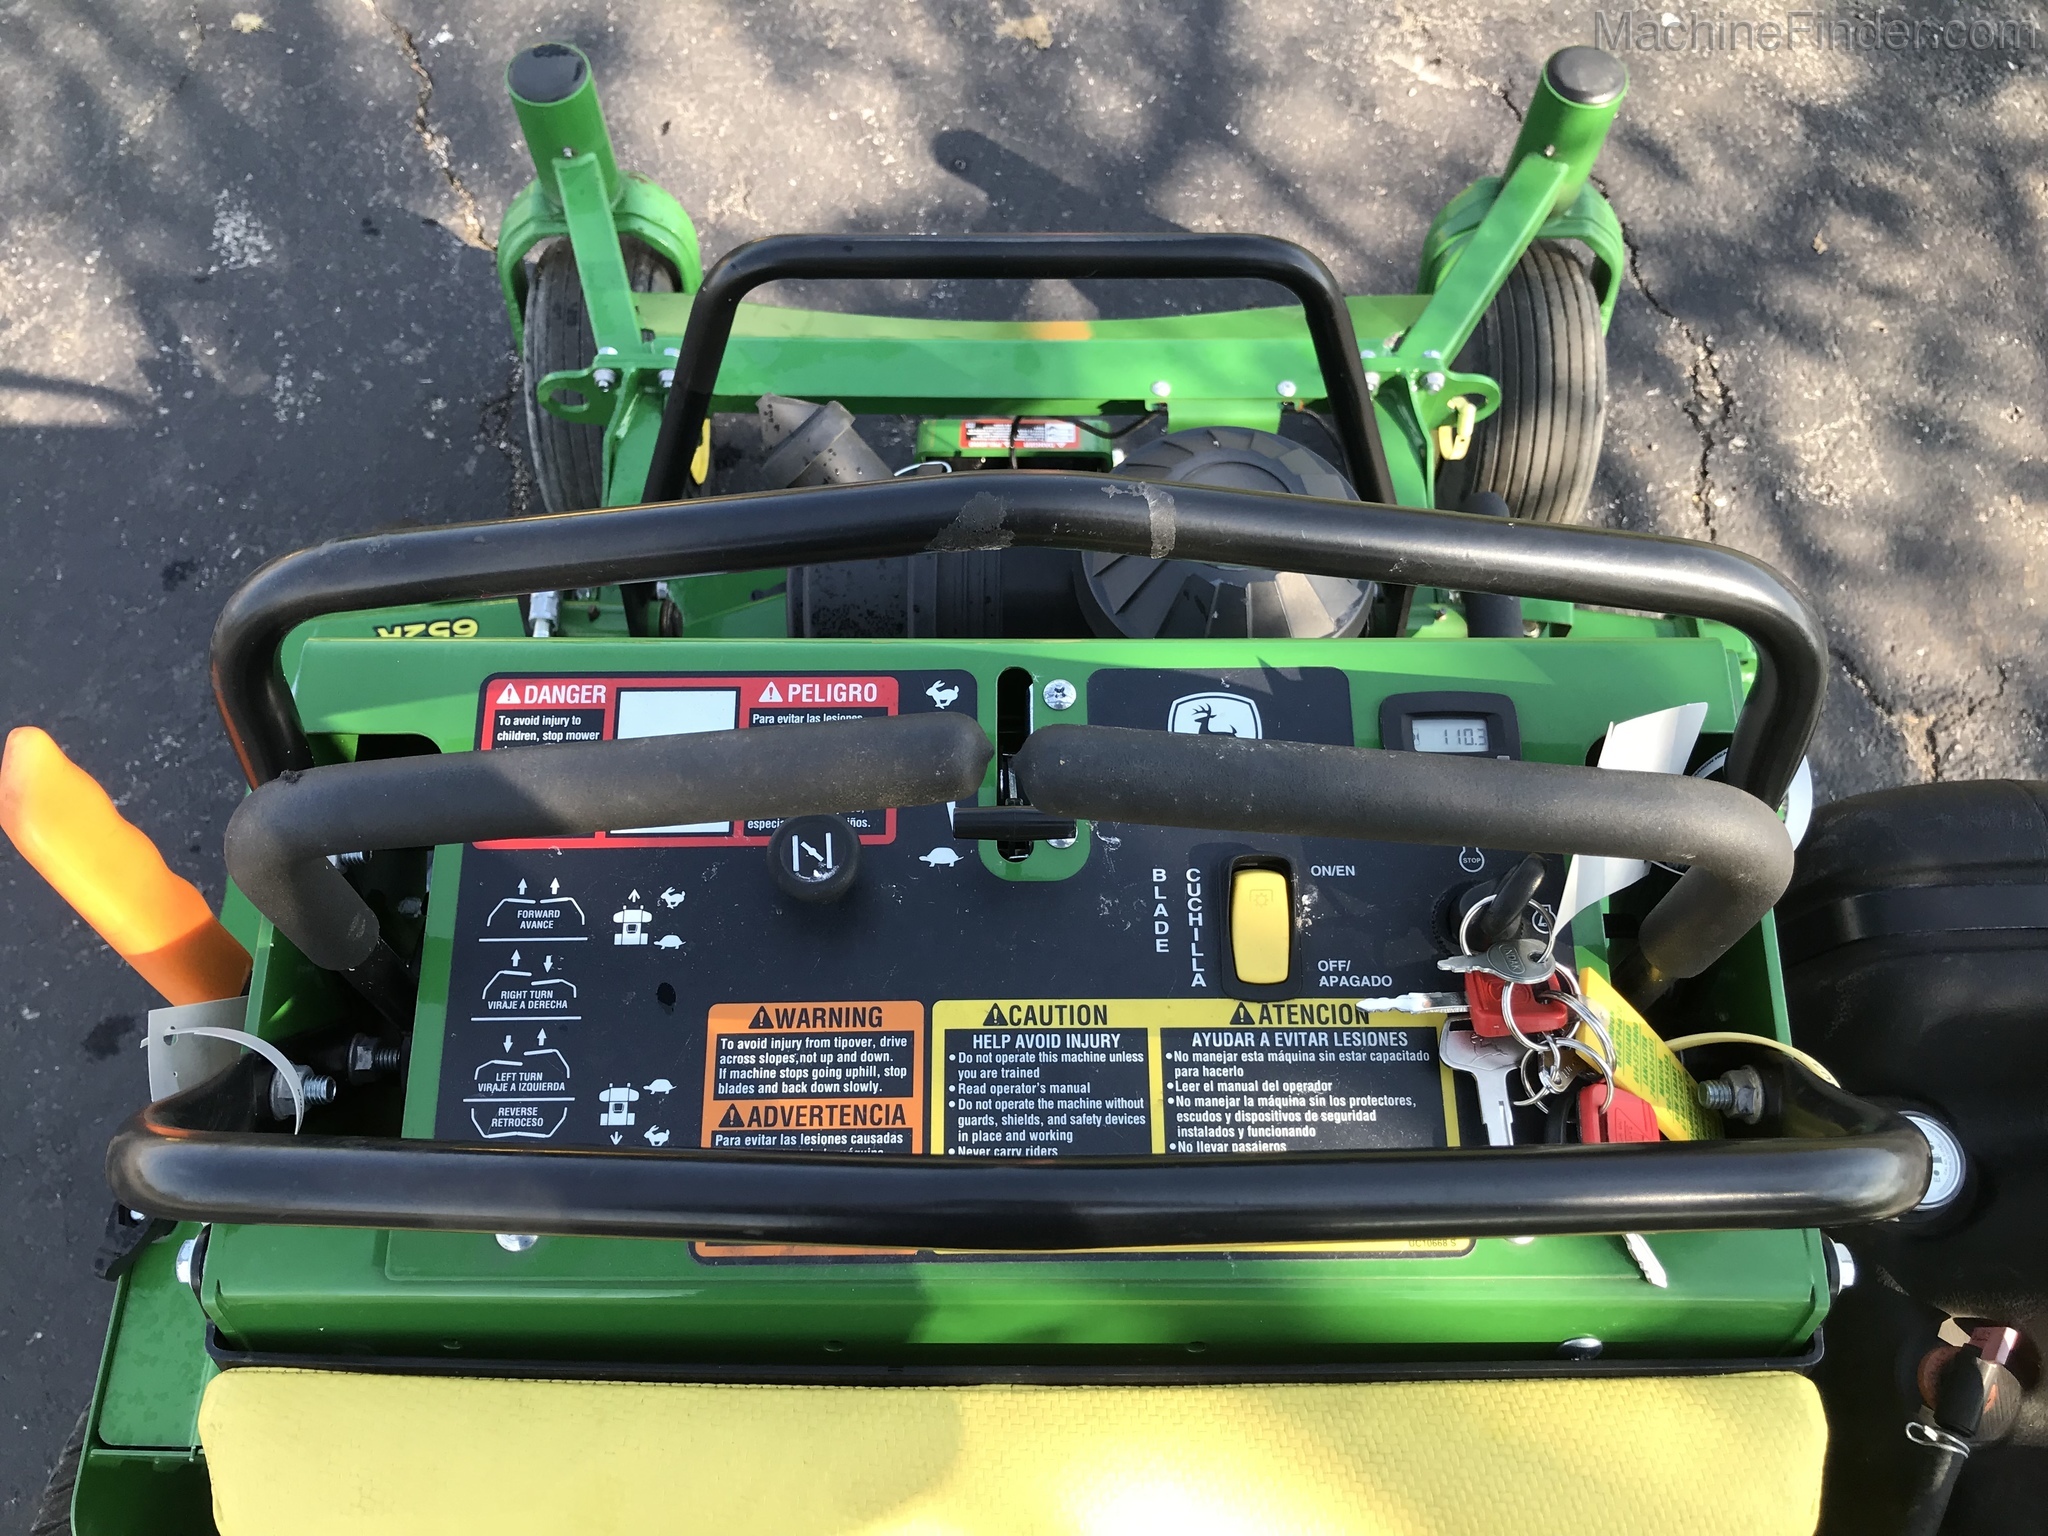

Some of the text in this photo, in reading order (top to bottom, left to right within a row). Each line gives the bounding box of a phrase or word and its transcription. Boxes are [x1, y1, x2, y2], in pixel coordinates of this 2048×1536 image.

[524, 685, 606, 704] DANGER
[788, 683, 877, 702] PELIGRO
[499, 715, 581, 727] To avoid injury to
[752, 714, 775, 724] Para
[778, 713, 803, 724] evitar
[807, 714, 820, 723] las
[497, 731, 600, 742] children, stop mower
[1444, 728, 1487, 745] 110.3
[1310, 865, 1356, 877] ON/EN
[517, 909, 560, 919] FORWARD
[1152, 868, 1170, 953] BLADE
[519, 920, 554, 929] AVANCE
[1185, 868, 1207, 987] CUCHILLA
[1317, 959, 1351, 973] OFF/
[1319, 975, 1393, 987] APAGADO
[500, 990, 553, 1000] RIGHT TURN
[488, 1000, 568, 1010] VIRAJE A DERECHA
[775, 1006, 883, 1029] WARNING
[1009, 1005, 1108, 1026] CAUTION
[1258, 1003, 1370, 1025] ATENCION
[721, 1036, 908, 1052] To avoid injury from tipover, drive
[972, 1033, 1121, 1049] HELP AVOID INJURY
[1192, 1031, 1408, 1047] AYUDAR A EVITAR LESIONES
[719, 1050, 894, 1067] across slopes, not up and down.
[958, 1050, 1144, 1067] Do not operate this machine unless
[1173, 1051, 1430, 1064] No manejar esta máquina sin estar capacitado
[495, 1072, 543, 1081] LEFT TURN
[718, 1065, 907, 1081] If machine stops going uphill, stop
[958, 1067, 1040, 1081] you are trained
[1174, 1066, 1244, 1079] para hacerlo
[477, 1082, 565, 1092] VIRAJE A IZQUIERDA
[718, 1080, 883, 1095] blades and back down slowly.
[958, 1082, 986, 1095] Read
[1049, 1081, 1090, 1094] manual
[1175, 1080, 1332, 1093] Leer el manual del operador
[958, 1096, 1144, 1113] Do not operate the machine without
[1176, 1095, 1417, 1109] No manejar la máquina sin los protectores,
[498, 1107, 538, 1116] REVERSE
[747, 1103, 906, 1128] ADVERTENCIA
[1176, 1110, 1377, 1124] escudos y dispositivos de seguridad
[491, 1117, 544, 1127] RETROCESO
[958, 1112, 1146, 1128] guards, shields, and safety devices
[715, 1132, 904, 1146] Para evitar las lesiones causadas
[958, 1128, 1073, 1145] in place and working
[1177, 1125, 1316, 1140] instalados y funcionando
[958, 1146, 1058, 1156] Never carry riders
[1178, 1141, 1287, 1152] No llevar pasajeros
